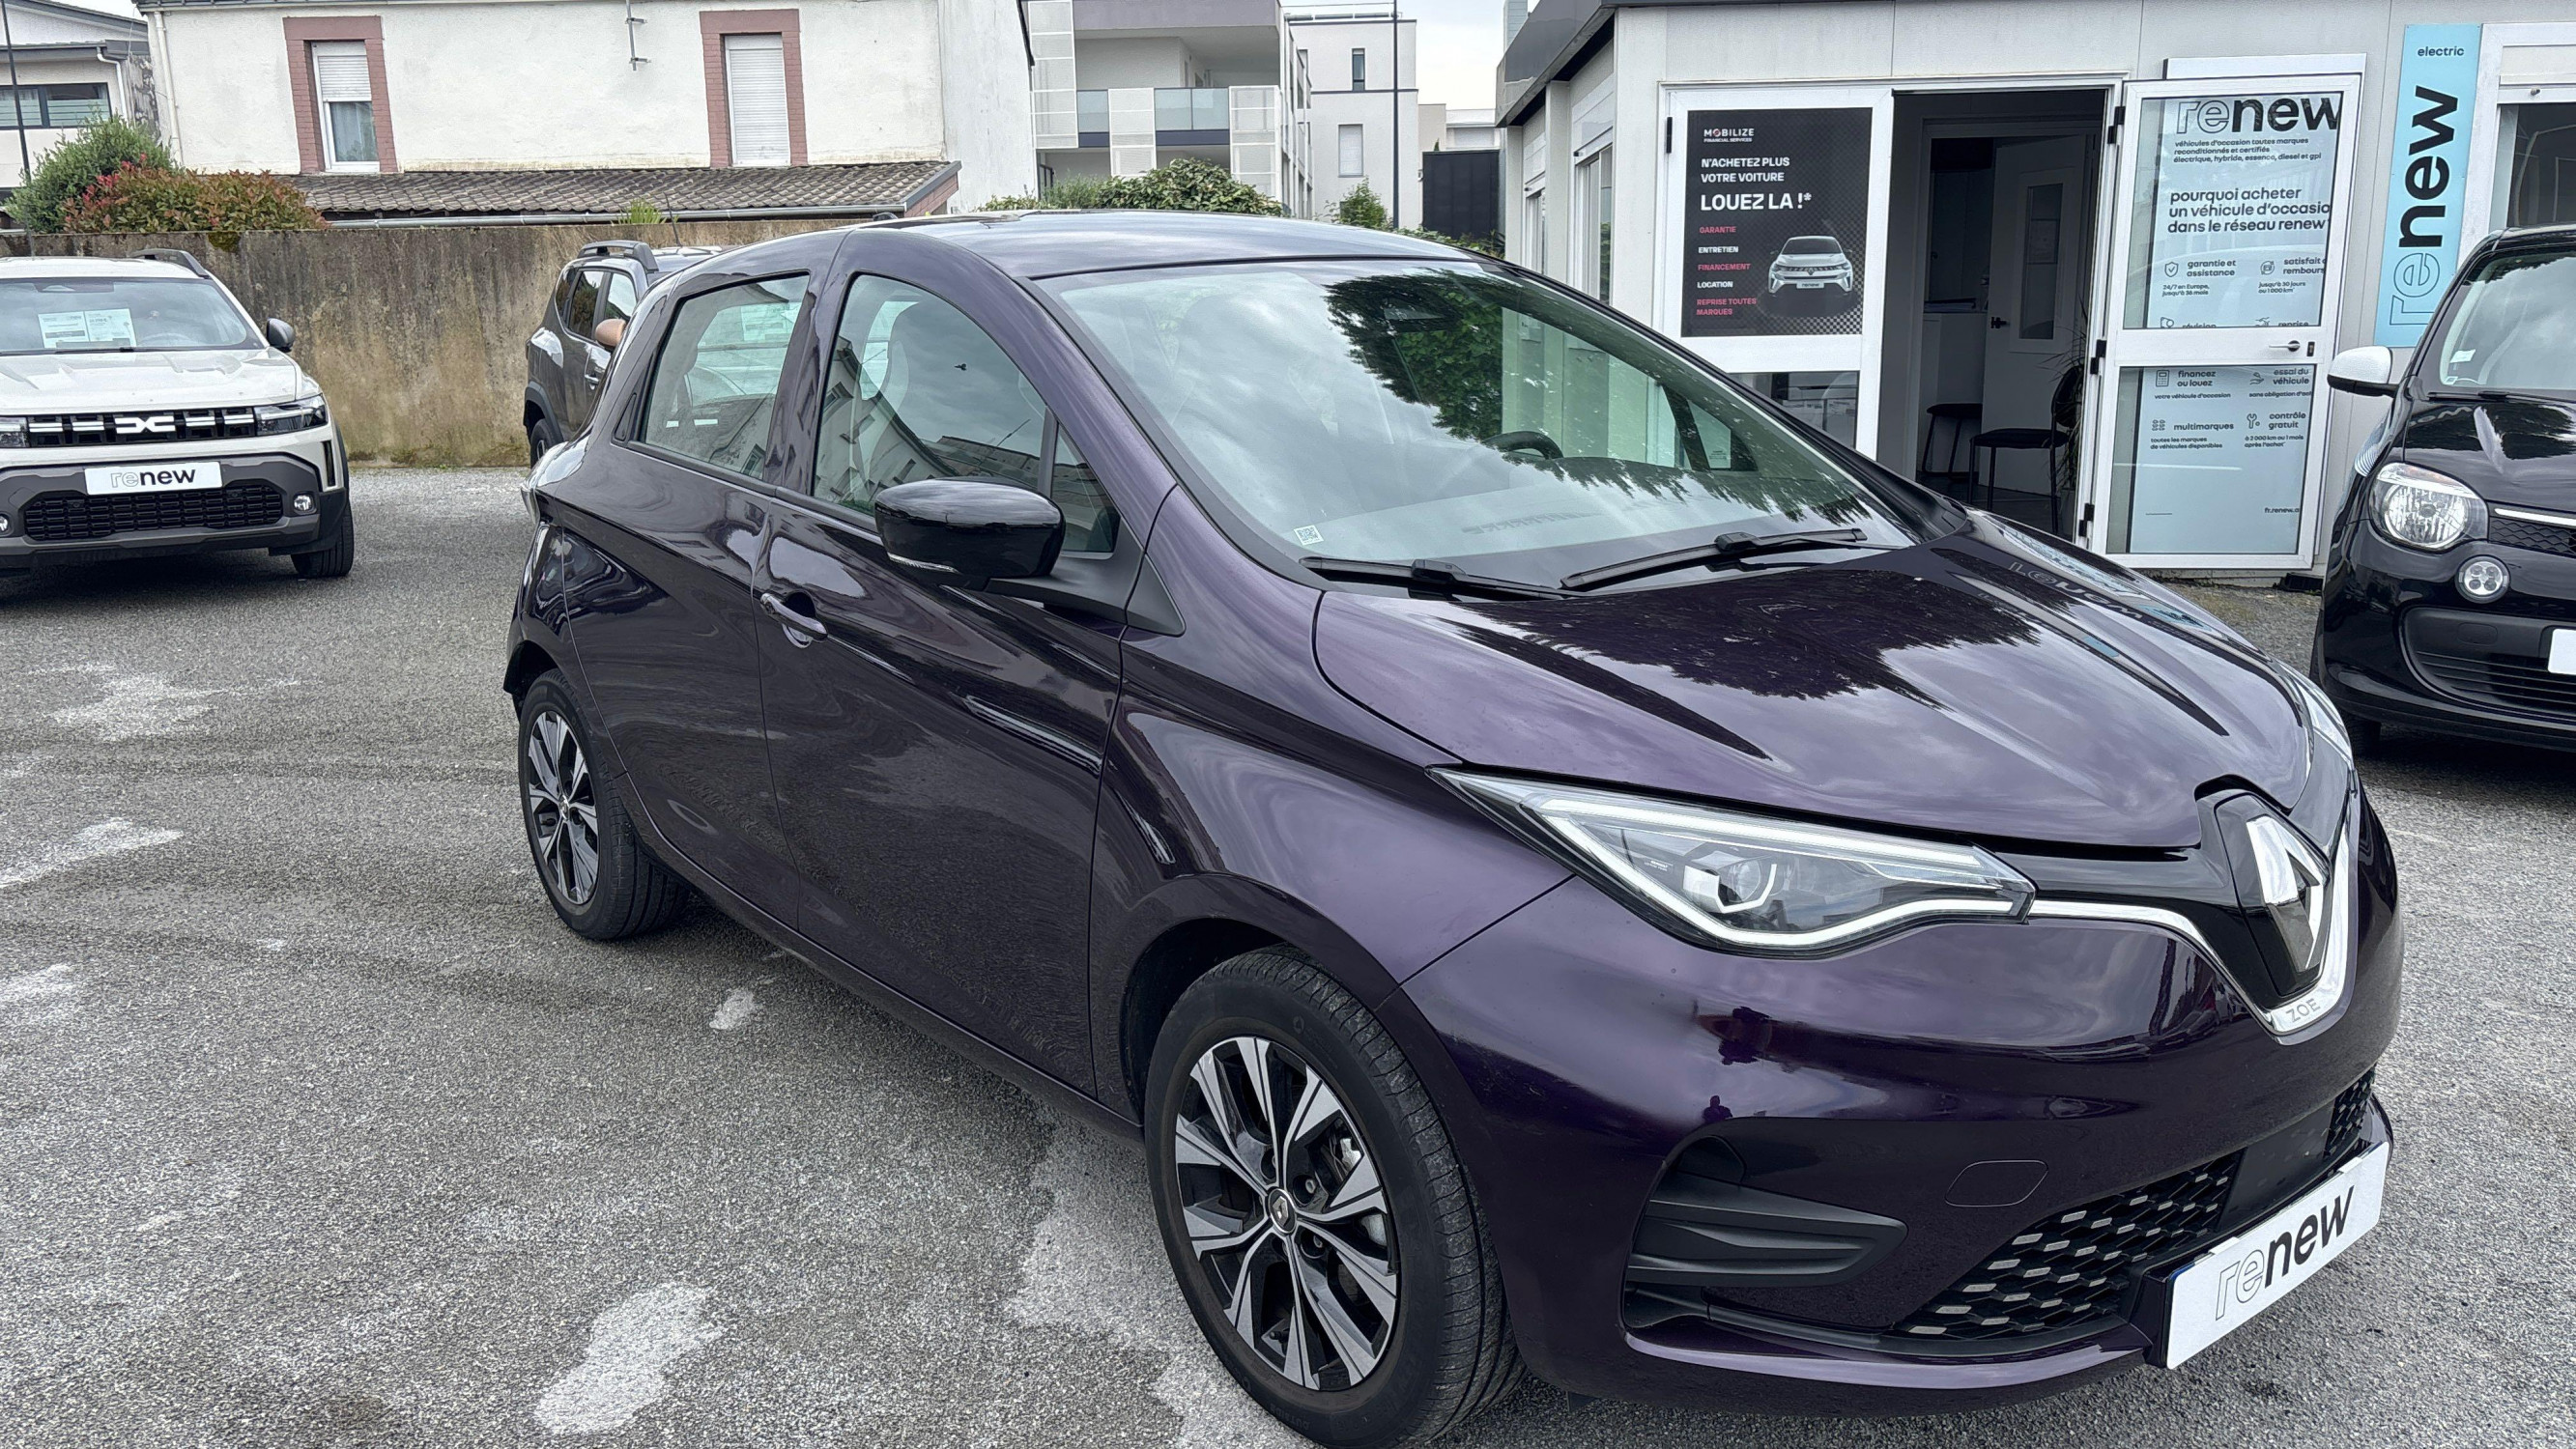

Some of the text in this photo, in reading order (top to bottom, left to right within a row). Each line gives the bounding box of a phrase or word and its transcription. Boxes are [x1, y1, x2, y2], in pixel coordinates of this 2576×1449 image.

[2418, 45, 2464, 56] electric
[2177, 98, 2339, 134] renew
[1703, 128, 1755, 137] MOBILIZE
[1701, 156, 1789, 168] N'ACHETEZ PLUS
[2309, 153, 2322, 161] gpl
[1701, 172, 1785, 183] VOTRE VOITURE
[1701, 193, 1764, 211] LOUEZ
[1768, 192, 1793, 210] LA
[2170, 187, 2302, 205] pourquoi acheter
[2169, 207, 2188, 217] un
[2191, 203, 2253, 217] véhicule
[2390, 85, 2458, 326] renew
[2167, 220, 2205, 233] dans
[2209, 220, 2221, 231] le
[2224, 219, 2275, 231] réseau
[2188, 259, 2225, 269] garantie
[2268, 421, 2299, 430] gratuit
[110, 469, 196, 488] renew
[2286, 998, 2321, 1024] ZOE
[2216, 1186, 2354, 1321] renew
